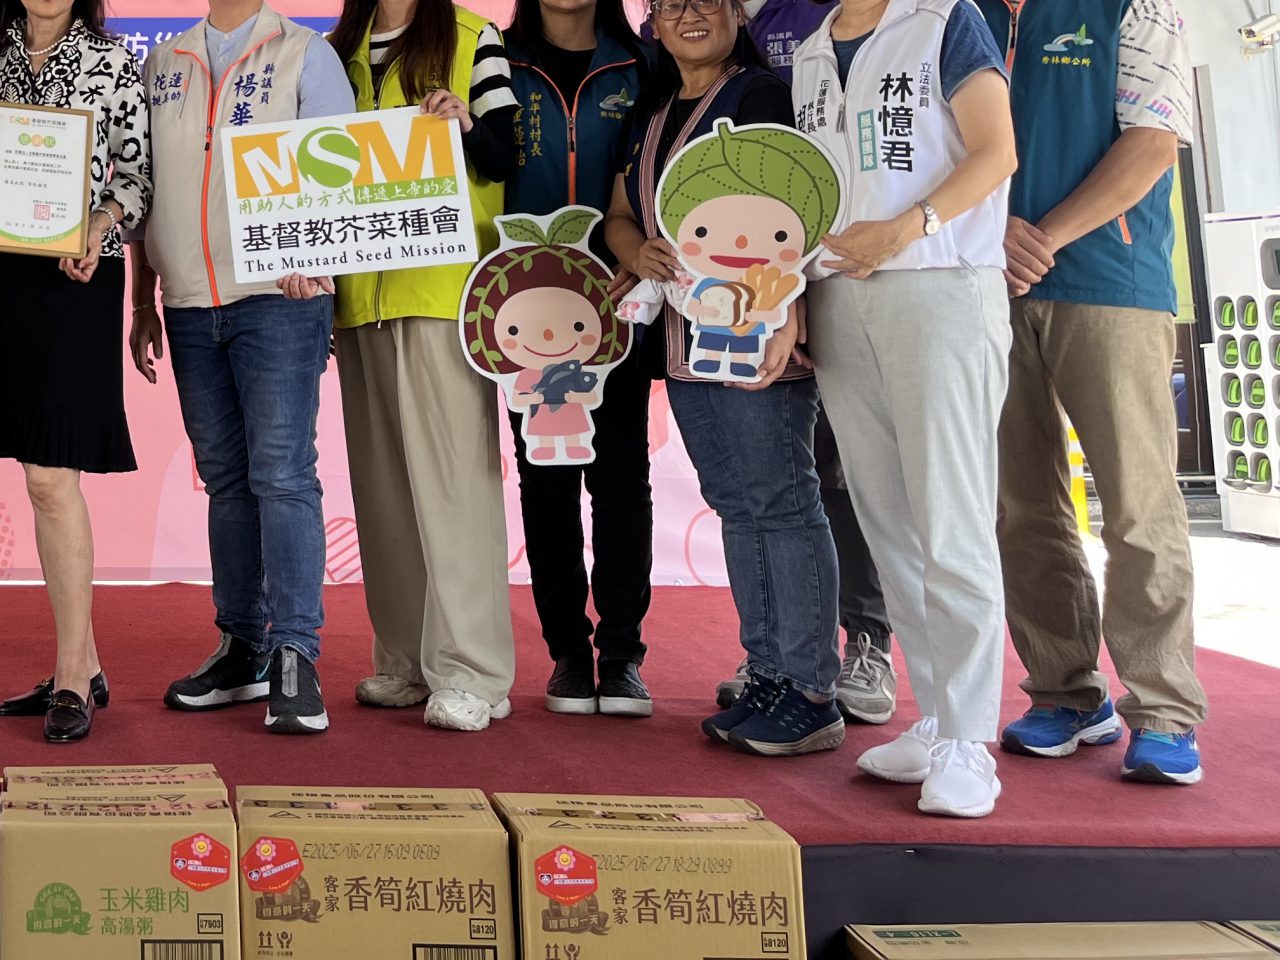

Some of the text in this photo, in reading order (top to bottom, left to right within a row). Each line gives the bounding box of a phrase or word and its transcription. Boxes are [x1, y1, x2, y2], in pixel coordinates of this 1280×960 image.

[260, 63, 275, 104] 縣議員
[919, 62, 932, 108] 立法委員
[529, 92, 543, 157] 和平村村長
[860, 113, 875, 167] 服務團隊
[878, 72, 915, 172] 林憶君
[239, 189, 354, 215] 用助人的方式
[355, 180, 456, 203] 傳遞上帝的愛
[242, 205, 461, 253] 基督教芥菜種會
[245, 243, 467, 273] The Mustard Seed Mission
[99, 887, 190, 913] 玉米雞肉
[324, 875, 340, 912] 客家
[343, 875, 496, 915] 香筍紅燒肉
[612, 887, 628, 925] 客家
[632, 887, 789, 927] 香筍紅燒肉
[101, 916, 153, 936] 高湯粥
